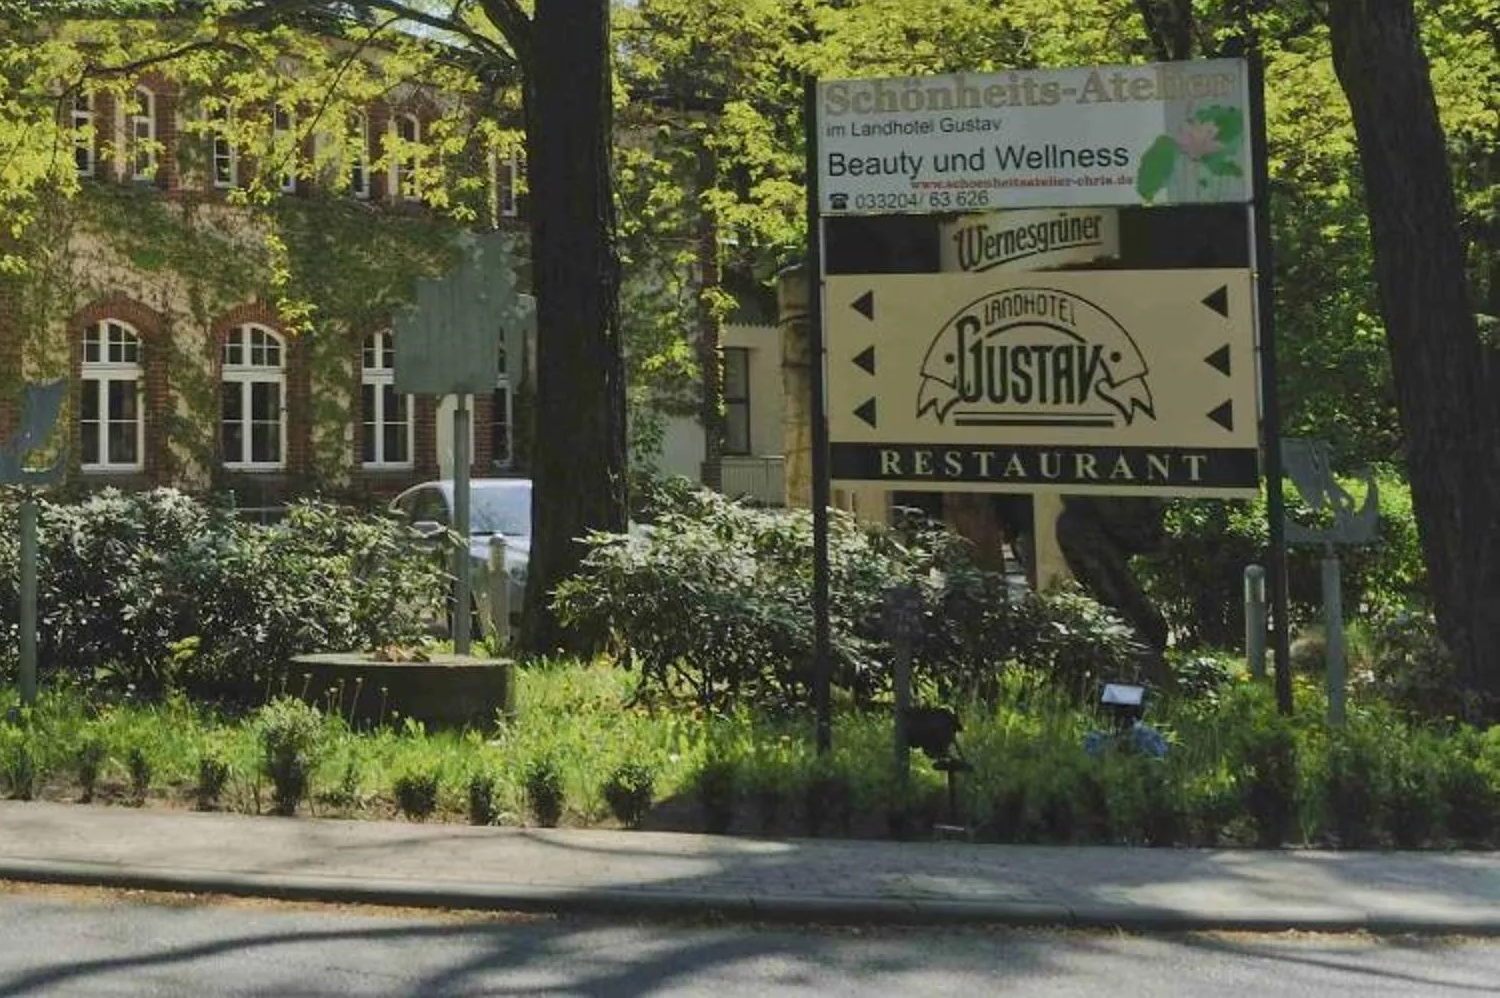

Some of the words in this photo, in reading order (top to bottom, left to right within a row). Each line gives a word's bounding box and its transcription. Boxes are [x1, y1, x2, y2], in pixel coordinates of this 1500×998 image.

[825, 65, 1236, 117] Schönheits-Atelier
[827, 123, 845, 138] im
[852, 119, 934, 137] Landhotel
[940, 117, 1002, 133] Gustav
[829, 150, 923, 180] Beauty
[934, 146, 985, 173] und
[996, 144, 1130, 171] Wellness
[956, 189, 989, 206] 626
[953, 212, 1102, 271] Wernesgrüner
[984, 293, 1077, 327] LANDHOTEL
[955, 315, 1104, 405] GUSTAV
[881, 449, 1207, 481] RESTAURANT
